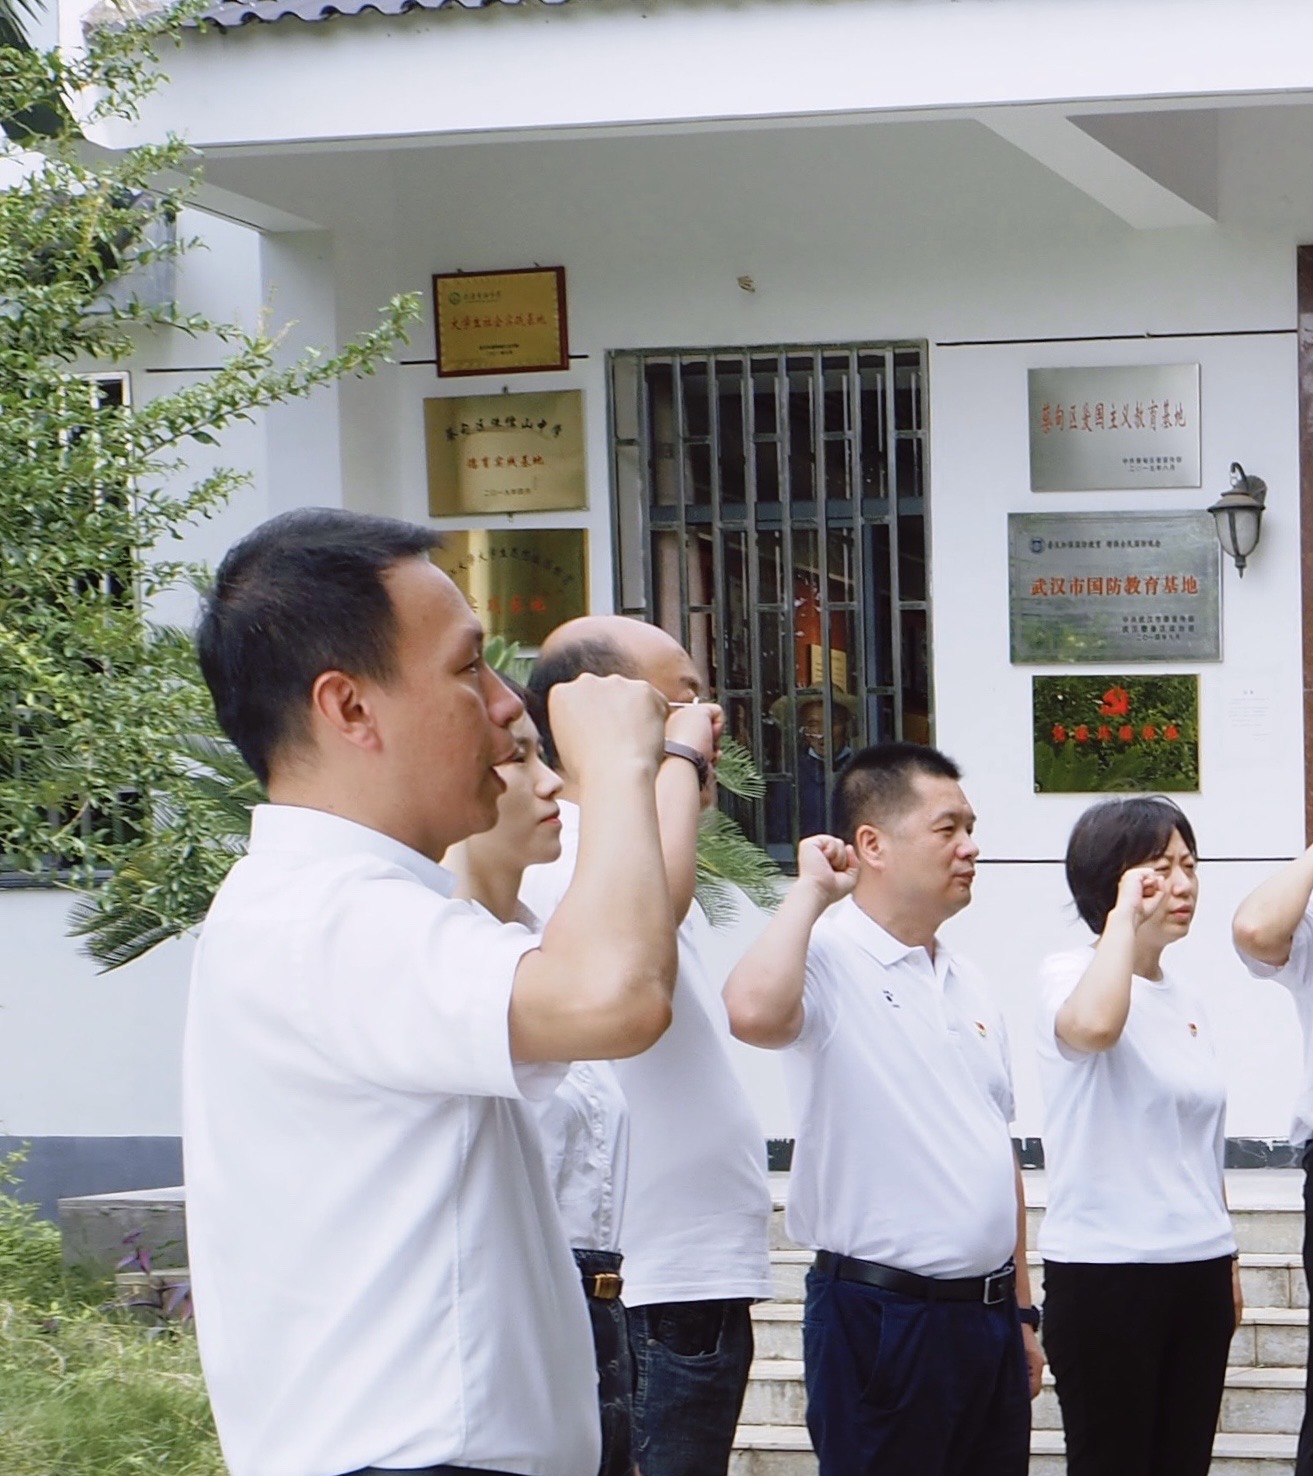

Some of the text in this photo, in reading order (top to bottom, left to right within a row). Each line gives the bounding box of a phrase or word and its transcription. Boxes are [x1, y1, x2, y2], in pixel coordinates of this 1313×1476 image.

[1030, 575, 1198, 596] 武汉市国防教育基地
